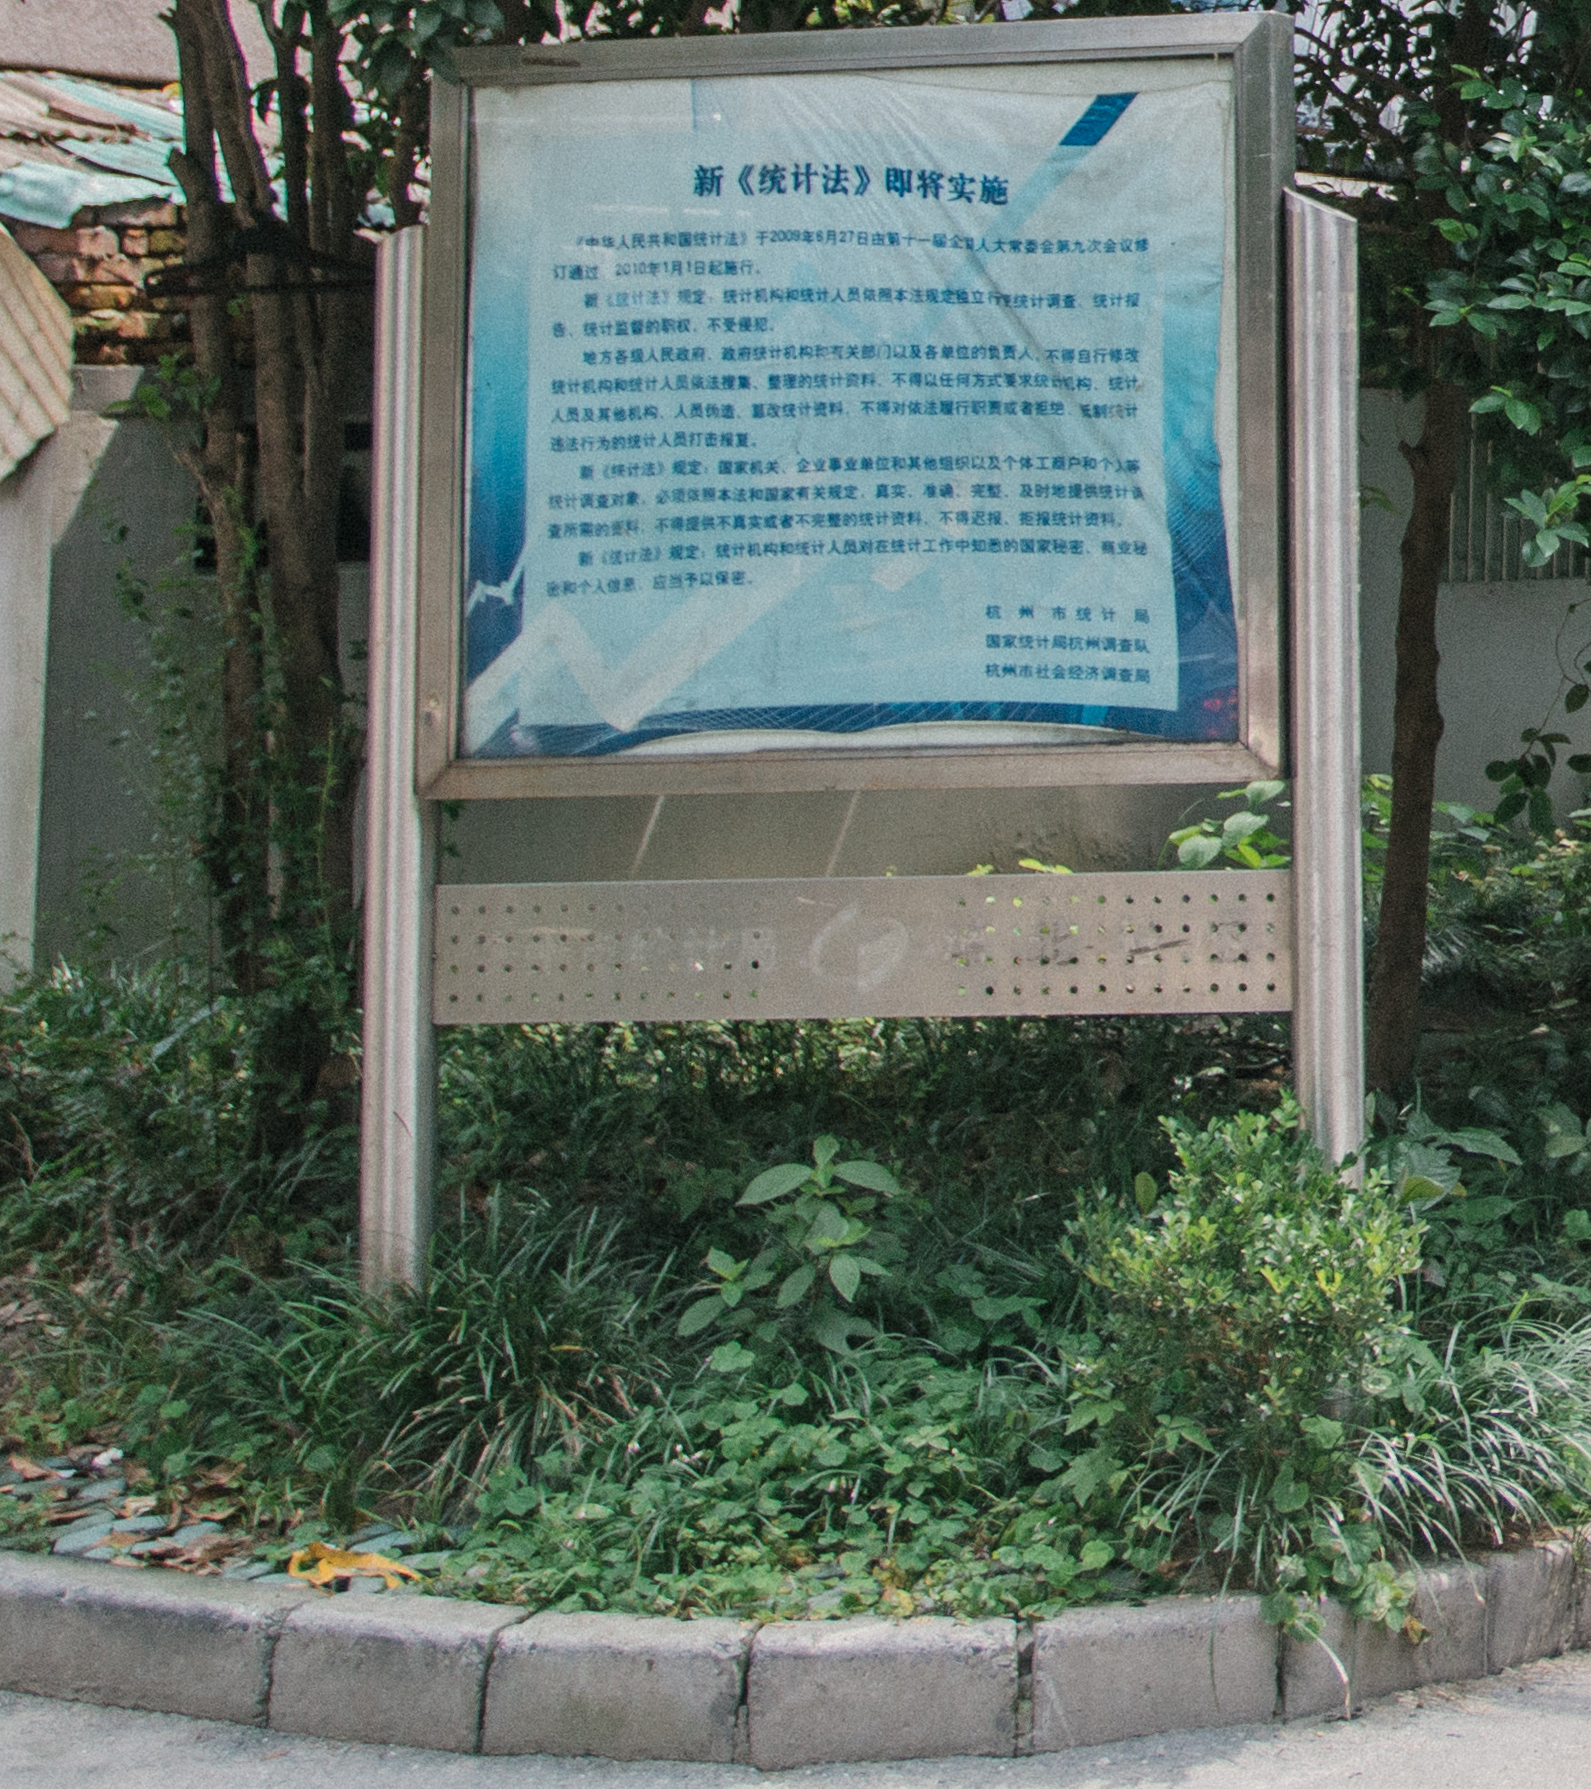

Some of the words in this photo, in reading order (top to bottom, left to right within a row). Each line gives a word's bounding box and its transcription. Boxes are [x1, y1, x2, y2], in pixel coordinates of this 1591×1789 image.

[693, 163, 1009, 205] 新《统计法》即将实施
[985, 634, 1150, 653] 国家统计局杭州调查队
[985, 664, 1150, 684] 杭州市社会经济调查局
